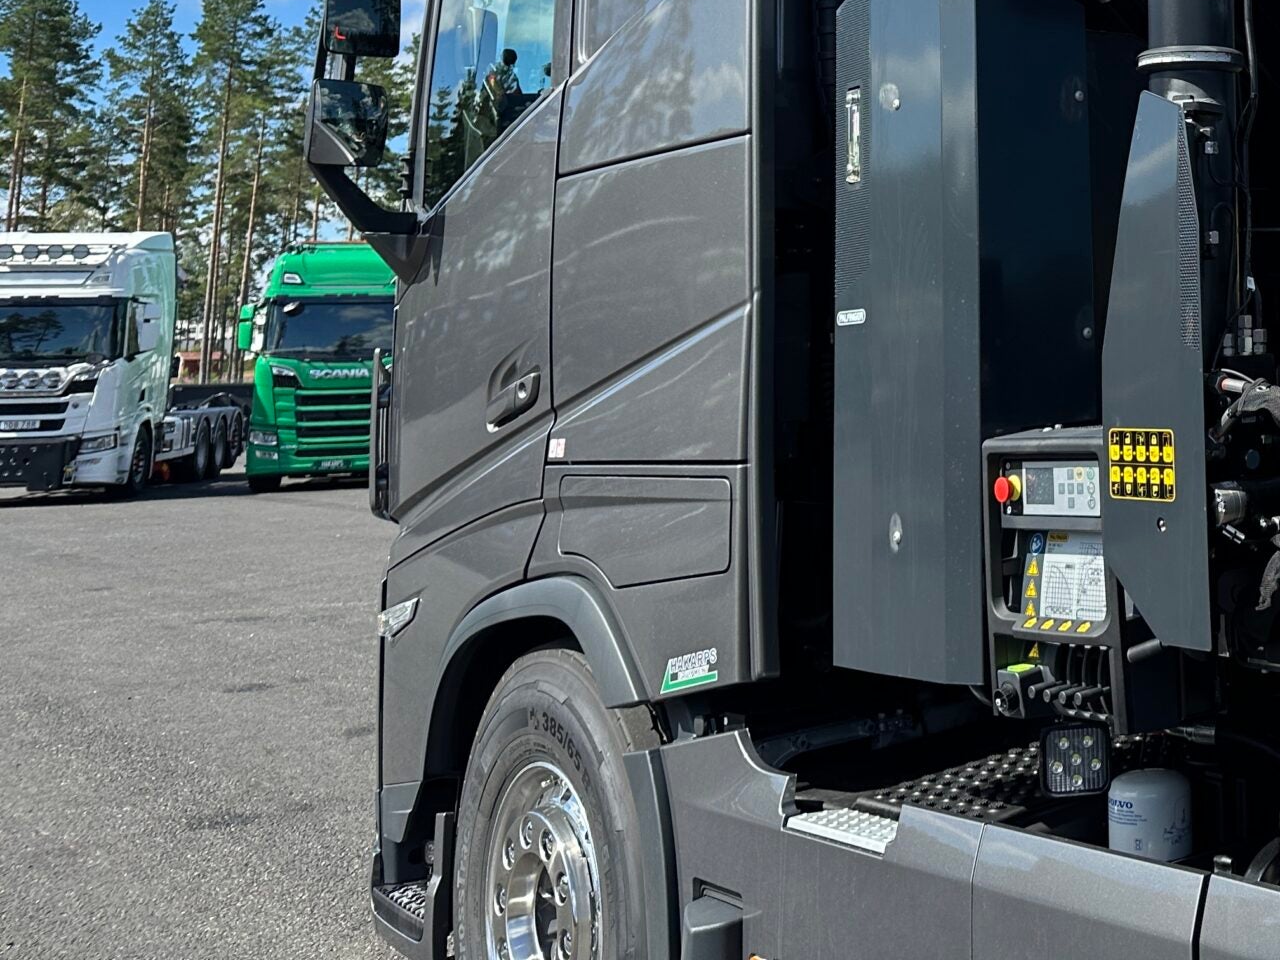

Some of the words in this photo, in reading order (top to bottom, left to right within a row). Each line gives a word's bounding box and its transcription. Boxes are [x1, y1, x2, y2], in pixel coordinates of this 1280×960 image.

[309, 368, 369, 380] SCANIA
[669, 647, 718, 674] HAKARPS
[541, 710, 583, 772] 385/65
[1108, 799, 1133, 809] OLVO
